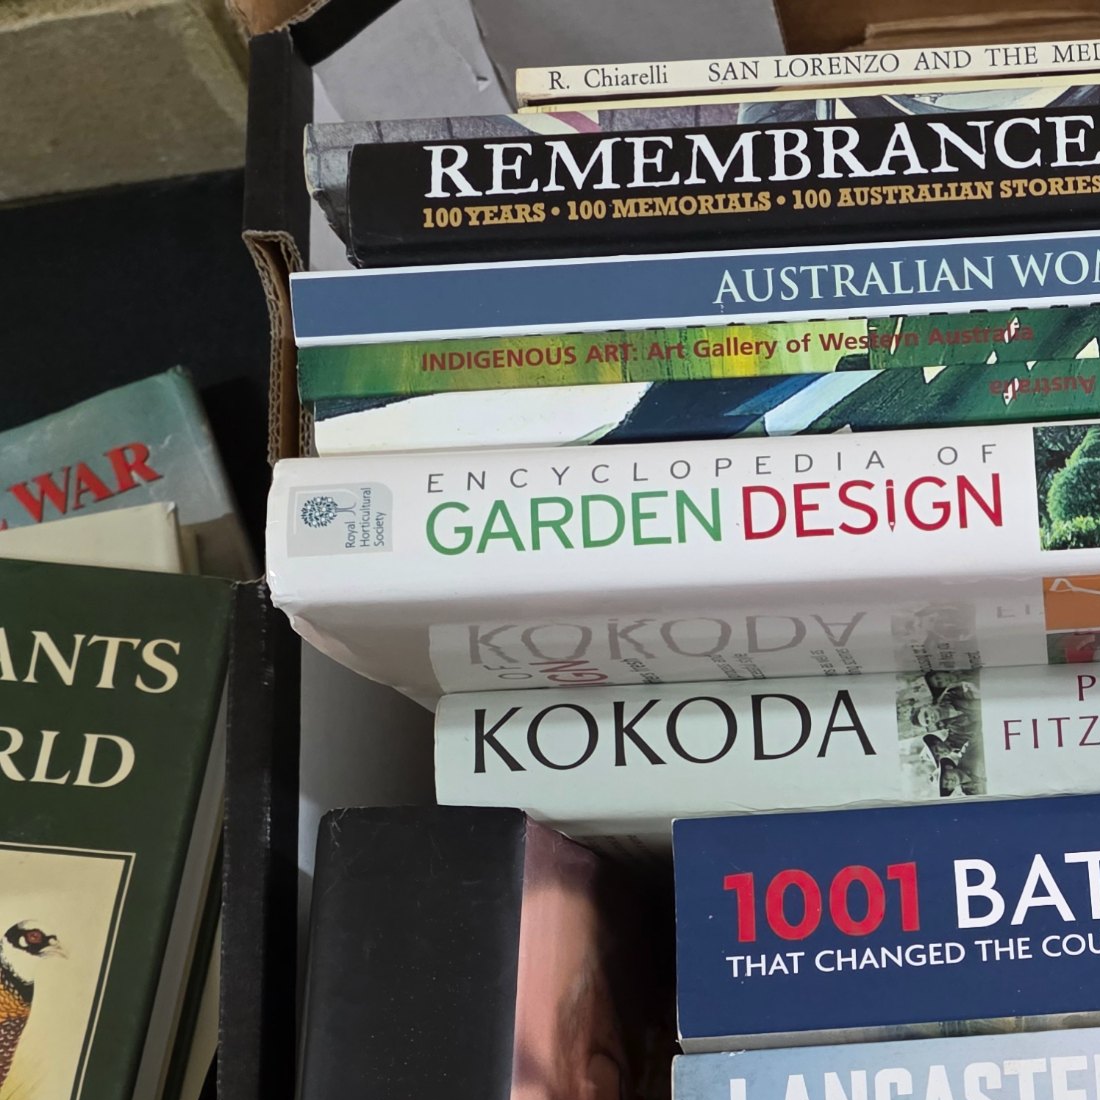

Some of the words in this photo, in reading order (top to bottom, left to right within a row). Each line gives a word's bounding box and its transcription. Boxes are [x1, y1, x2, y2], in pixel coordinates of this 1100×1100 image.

[549, 72, 570, 90] R.
[584, 64, 668, 88] Chiarelli
[708, 61, 759, 83] SAN
[774, 53, 900, 79] LORENZO
[913, 50, 972, 72] AND
[984, 46, 1038, 66] THE
[423, 207, 462, 228] 100
[464, 203, 546, 226] YEARS
[567, 200, 607, 220] 100
[612, 192, 771, 218] MEMORIALS
[793, 188, 831, 209] 100
[838, 180, 993, 206] AUSTRALIAN
[713, 256, 995, 304] AUSTRALIAN
[422, 346, 577, 371] INDIGENOUS
[585, 343, 638, 363] ART:
[647, 341, 685, 360] Art
[693, 330, 776, 359] Gallery
[786, 333, 811, 353] of
[818, 328, 919, 352] Western
[928, 321, 1034, 346] Australia
[989, 375, 1097, 401] Australia
[8, 441, 163, 523] WAR
[427, 450, 885, 494] ENCYCLOPEDIA
[937, 443, 998, 465] OF
[344, 521, 358, 548] Royal
[359, 487, 371, 547] Horticultural
[373, 511, 387, 546] Society
[426, 487, 722, 555] GARDEN
[741, 473, 1003, 540] DESIGN
[473, 689, 877, 774] KOKODA
[723, 861, 920, 943] 1001
[726, 951, 805, 978] THAT
[815, 942, 966, 972] CHANGED
[975, 937, 1034, 962] THE
